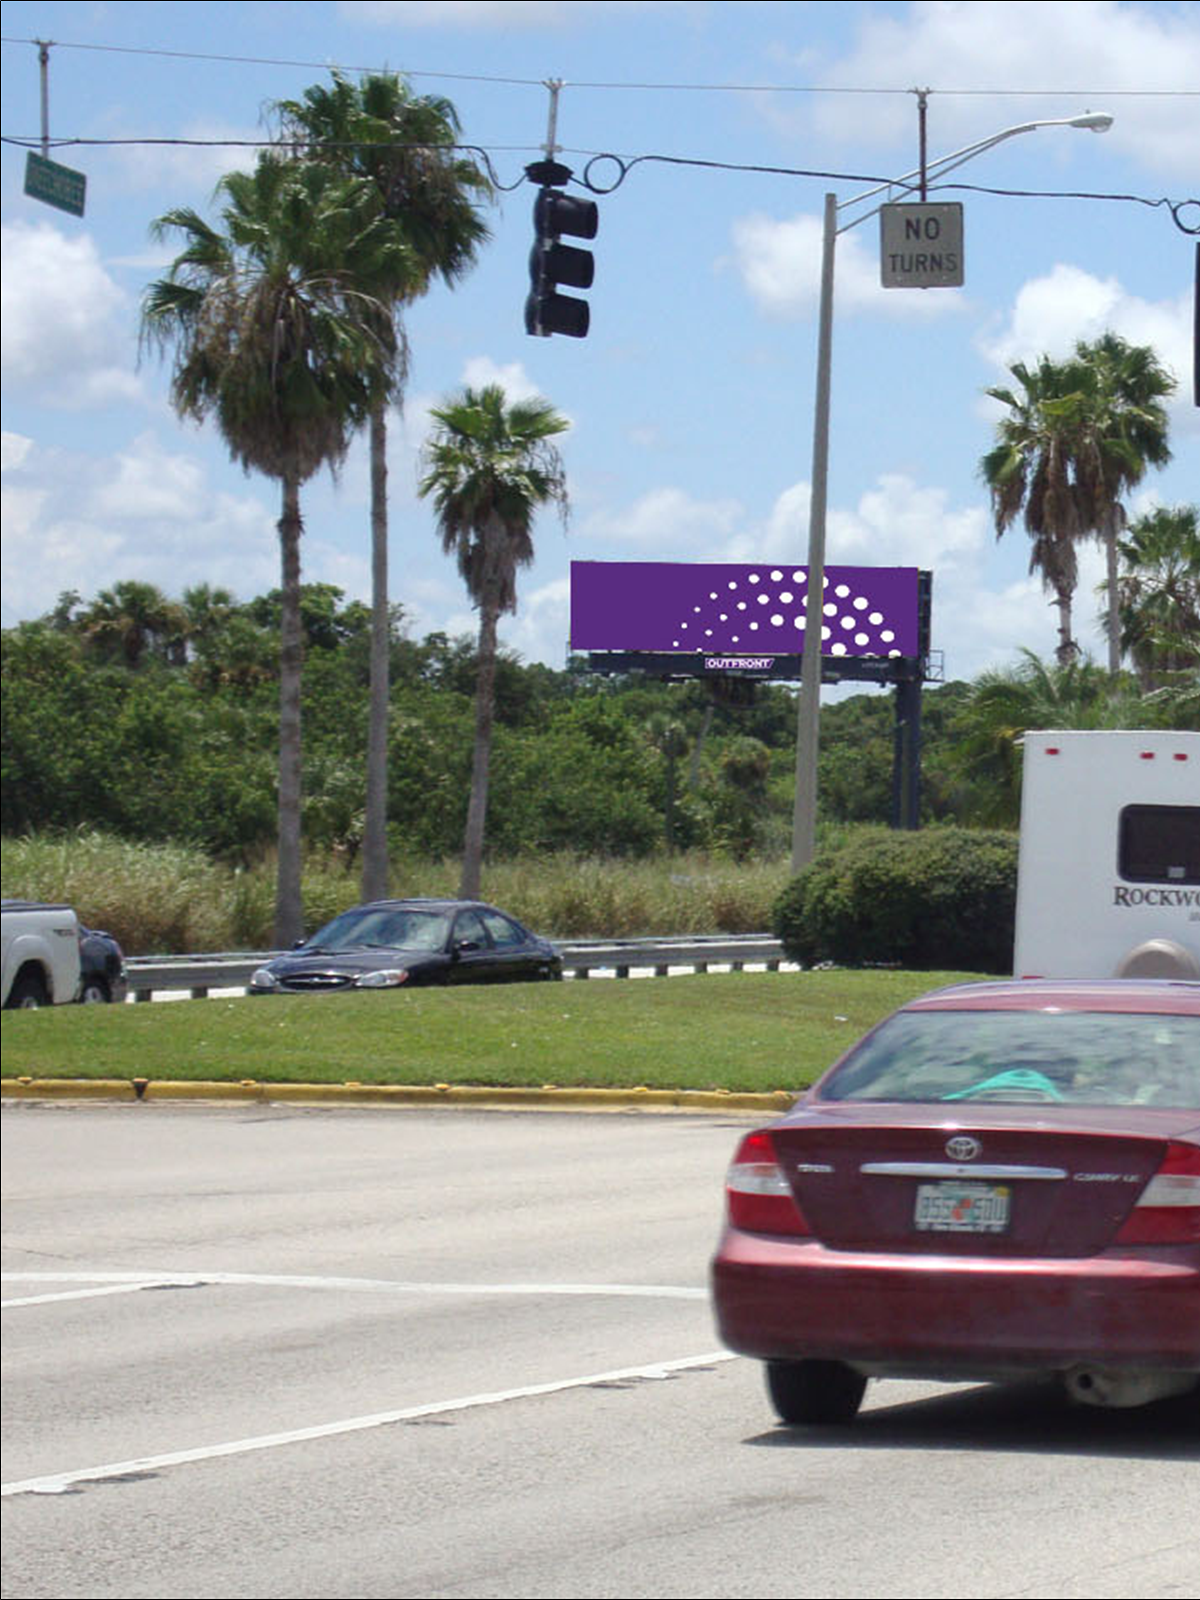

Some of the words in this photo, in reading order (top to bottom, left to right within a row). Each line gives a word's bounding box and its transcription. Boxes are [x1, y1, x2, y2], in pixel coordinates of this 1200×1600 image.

[905, 216, 940, 241] NO
[888, 252, 957, 274] TURNS
[707, 658, 771, 669] OUTFRONT
